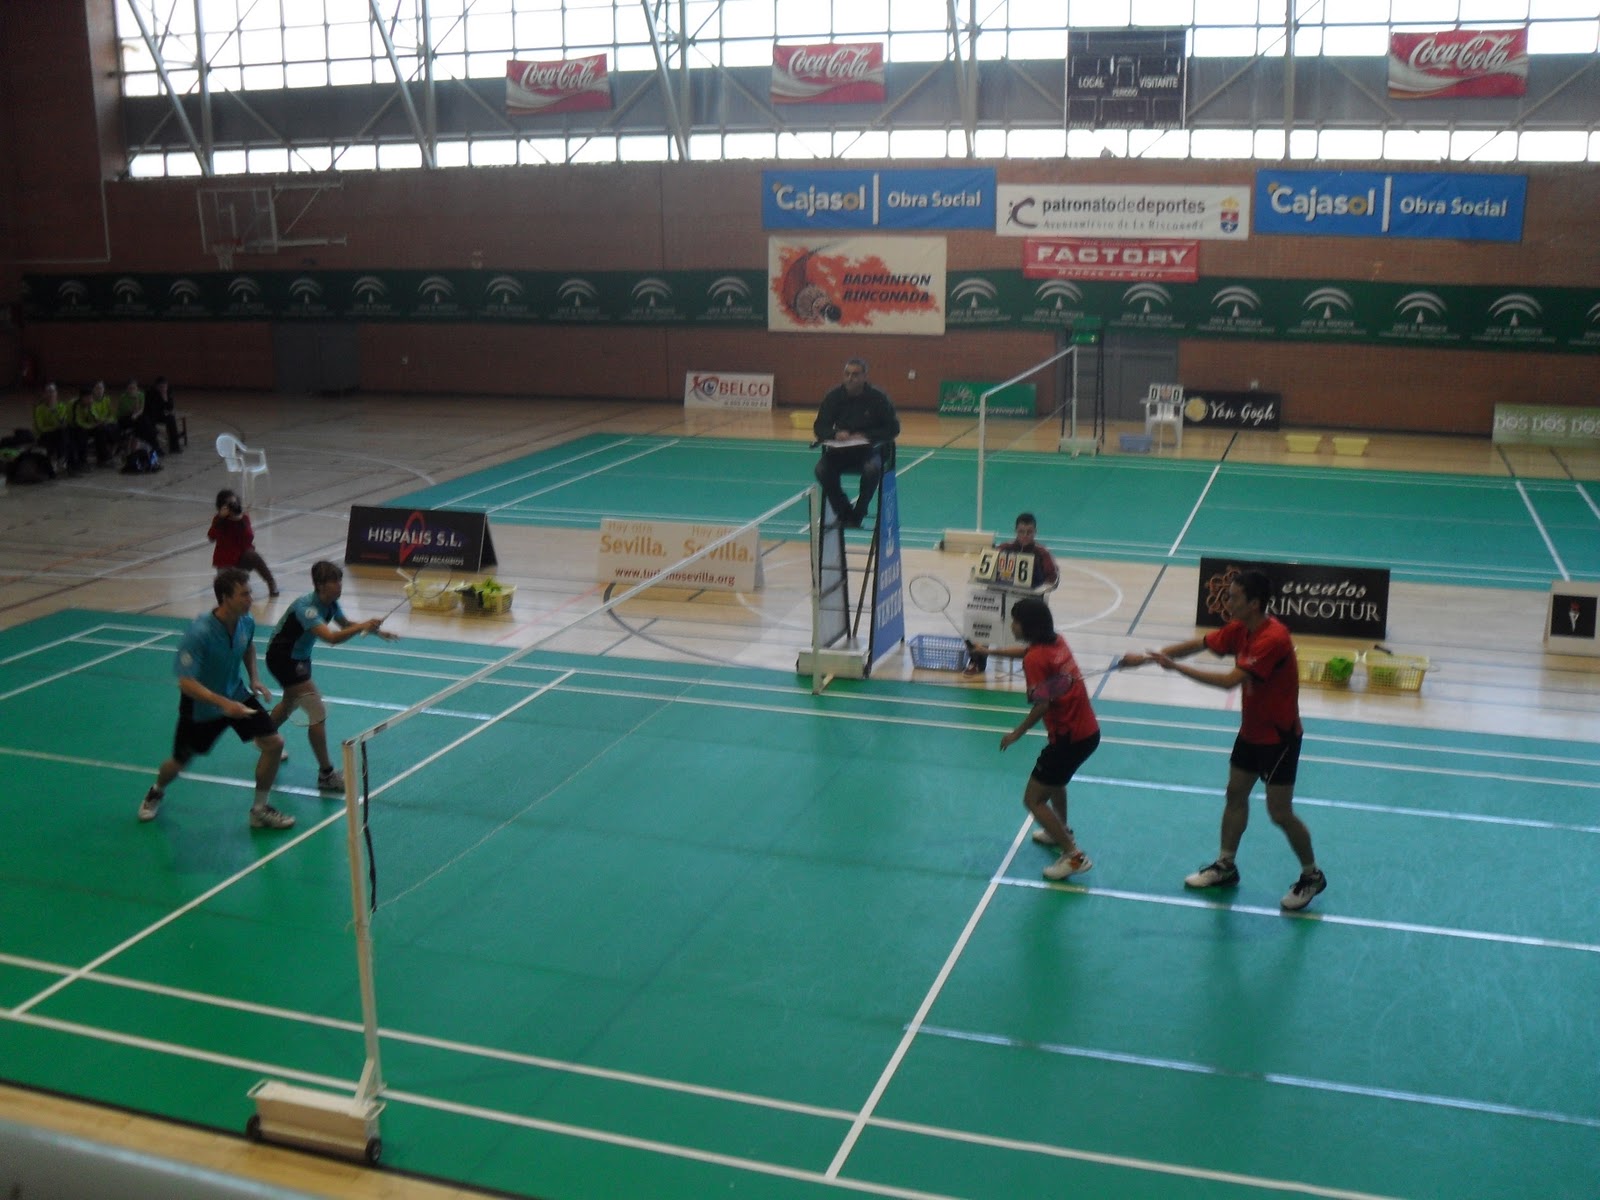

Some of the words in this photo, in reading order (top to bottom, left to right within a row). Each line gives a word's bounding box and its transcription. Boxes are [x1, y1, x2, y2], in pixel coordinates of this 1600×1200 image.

[788, 46, 874, 78] Coca-Cola
[1408, 35, 1515, 74] Coca-Cola
[519, 57, 596, 91] Coca-Cola
[1079, 76, 1104, 88] LOCAL
[1140, 76, 1179, 88] VISITANTE
[776, 184, 866, 218] Cajasol
[888, 190, 928, 208] Obra
[932, 189, 982, 208] Social
[1270, 187, 1376, 222] Cajasol
[1400, 197, 1447, 215] Obra
[1451, 198, 1508, 217] Social
[1037, 245, 1189, 265] FACTORY
[843, 272, 932, 287] BADMINTON
[843, 289, 930, 304] RINCONADA
[1241, 402, 1275, 425] Gogh
[368, 527, 432, 546] HISPALIS
[436, 532, 463, 547] S.L.
[600, 535, 667, 557] Sevilla.
[979, 554, 993, 574] 5
[1018, 561, 1028, 582] 6
[1281, 580, 1367, 598] eventos
[1265, 595, 1381, 621] RINCOTUR
